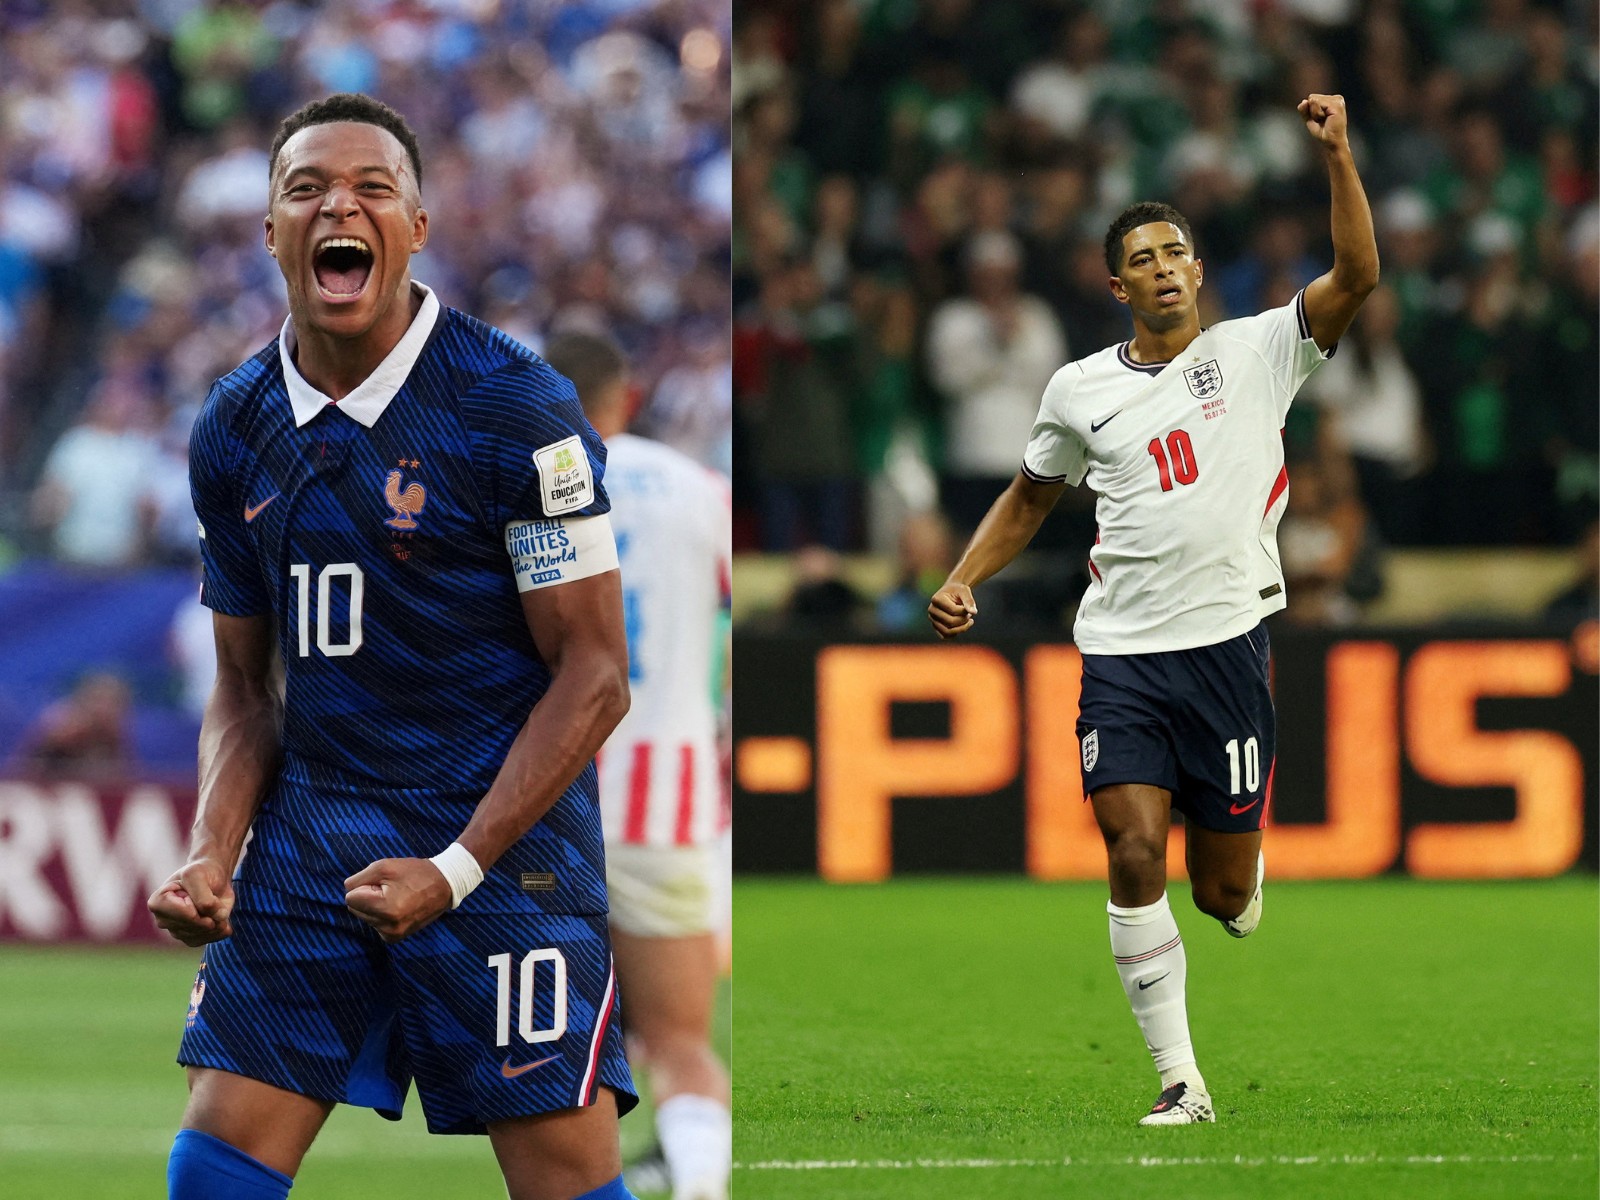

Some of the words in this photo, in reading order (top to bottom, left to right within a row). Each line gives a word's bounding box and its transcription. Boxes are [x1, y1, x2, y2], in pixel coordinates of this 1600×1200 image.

[1202, 398, 1225, 411] MEXICO
[1147, 429, 1199, 492] 10
[551, 480, 586, 501] EDUCATION
[565, 496, 579, 505] FIFA
[508, 518, 565, 540] FOOTBALL
[509, 529, 570, 558] UNITES
[514, 558, 532, 575] the
[534, 547, 577, 570] World
[532, 569, 562, 584] FIFA
[290, 562, 365, 657] 10
[1225, 736, 1260, 795] 10
[488, 947, 568, 1047] 10
